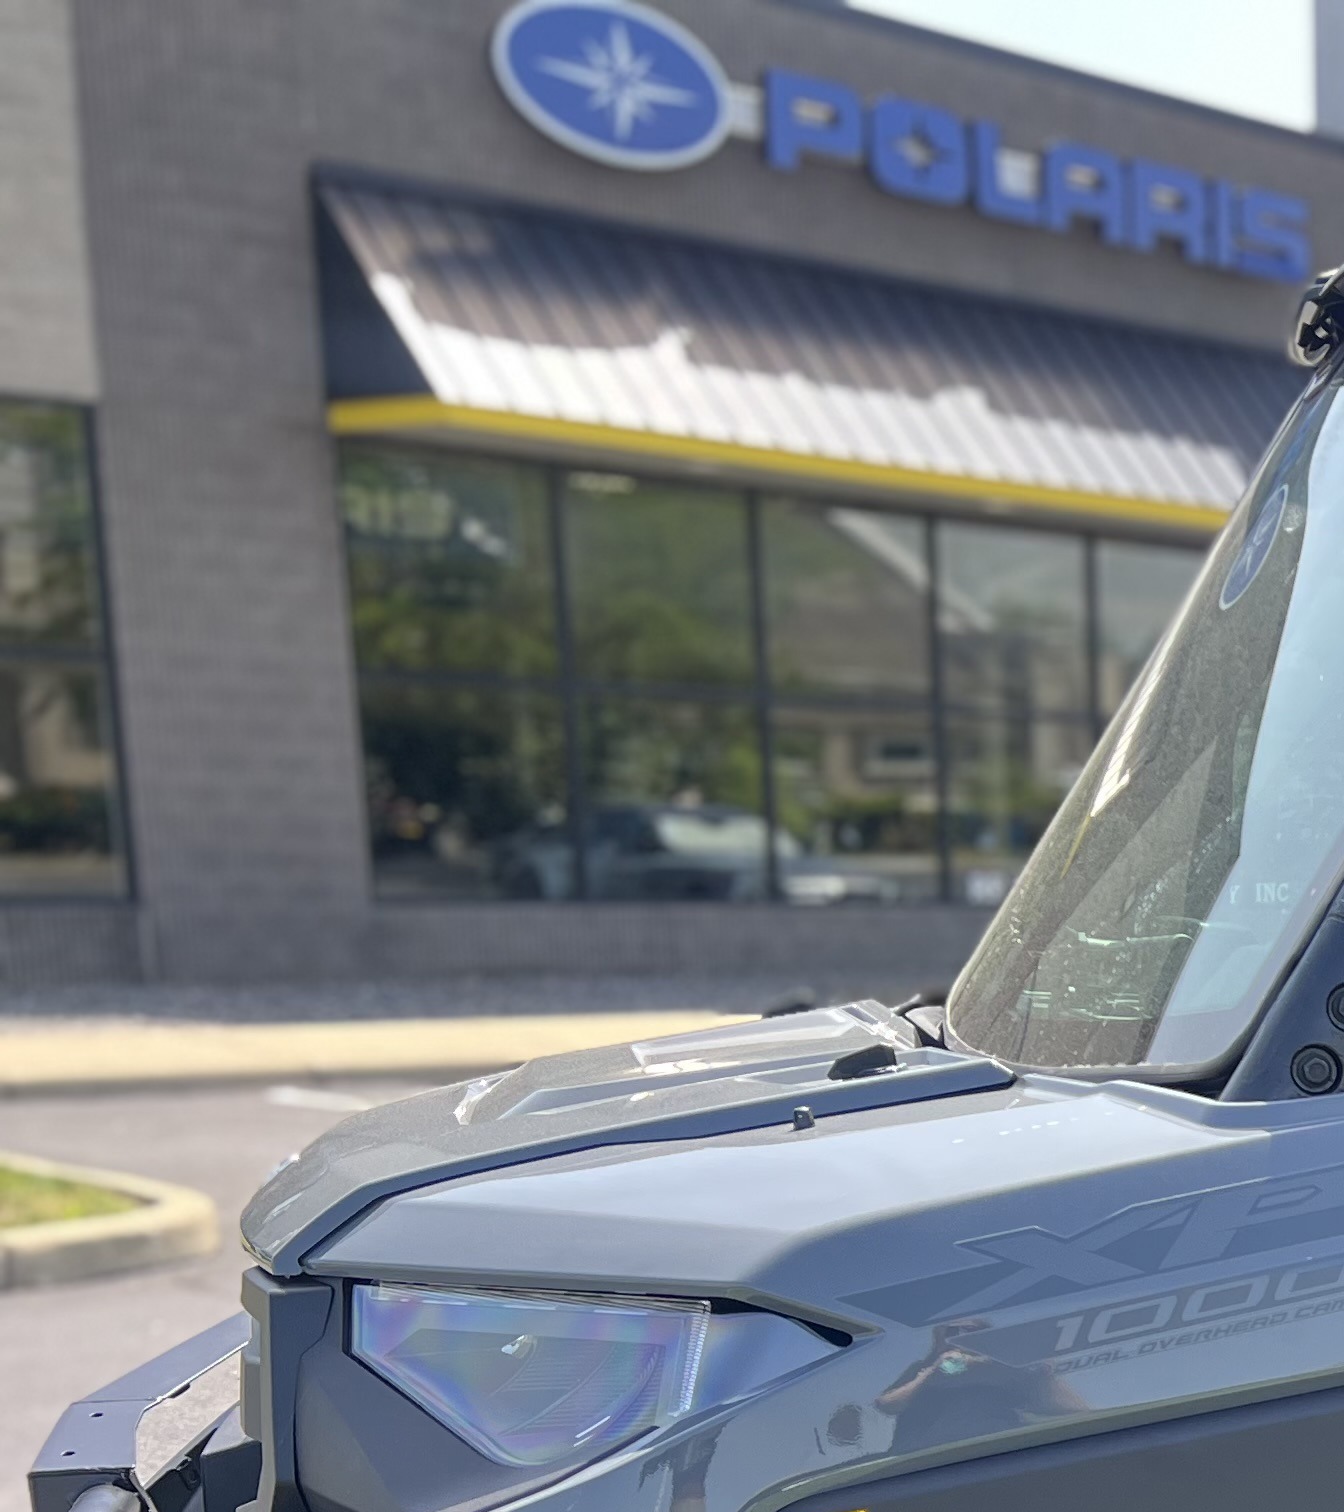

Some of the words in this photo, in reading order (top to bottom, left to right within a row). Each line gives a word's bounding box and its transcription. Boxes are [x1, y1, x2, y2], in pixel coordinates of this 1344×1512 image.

[764, 67, 1312, 284] POLARIS
[1255, 882, 1289, 904] INC
[1053, 1350, 1130, 1374] DUAL
[1138, 1311, 1287, 1353] OVERHEAD
